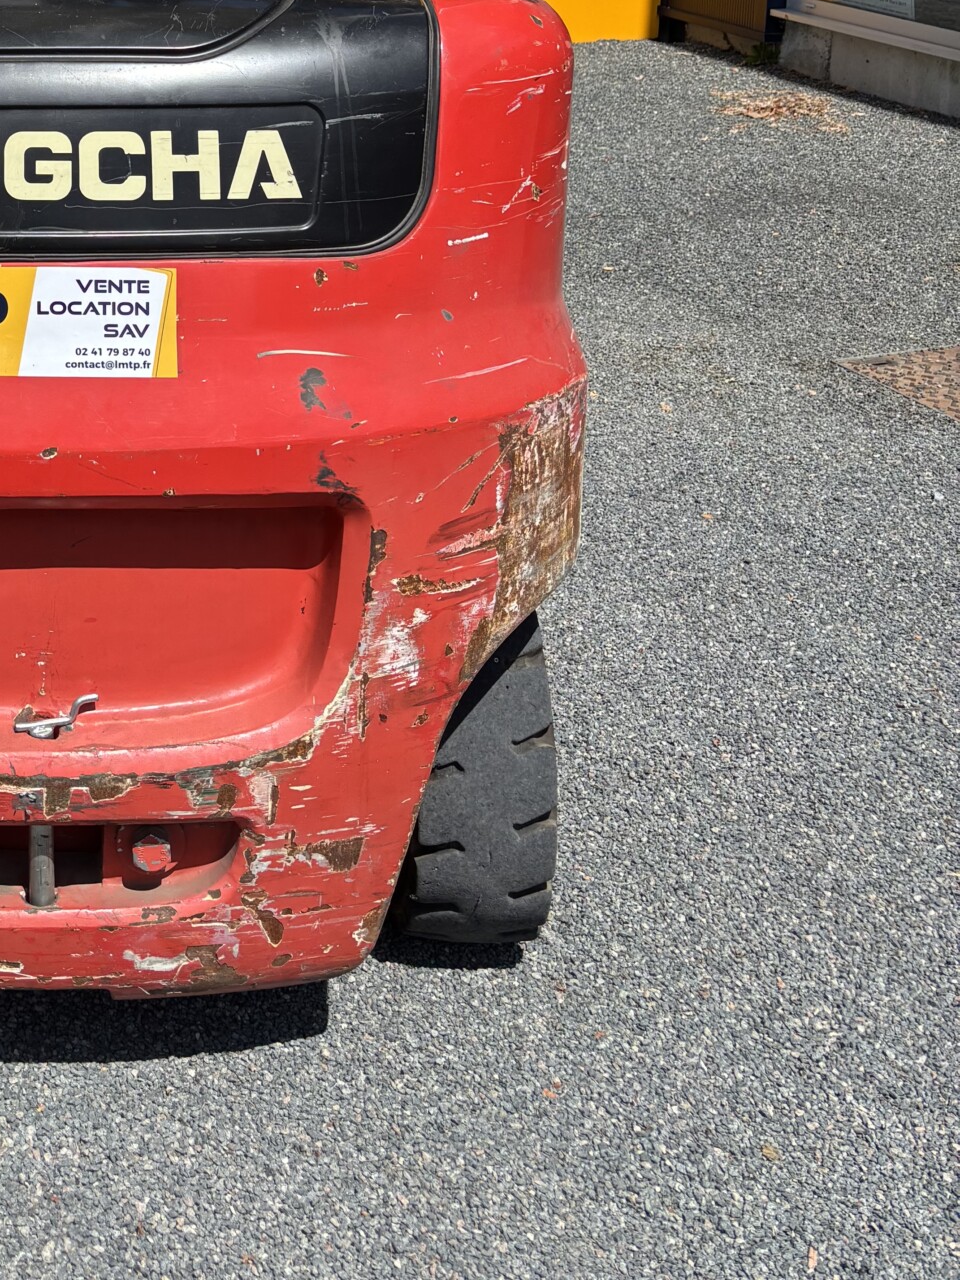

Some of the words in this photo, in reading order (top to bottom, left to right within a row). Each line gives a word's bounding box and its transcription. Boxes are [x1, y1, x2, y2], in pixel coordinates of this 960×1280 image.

[76, 279, 150, 294] VENTE
[36, 301, 150, 316] LOCATION
[103, 324, 150, 338] SAV
[75, 348, 88, 357] 02
[91, 348, 103, 357] 41
[106, 348, 120, 357] 79
[122, 348, 136, 357] 87
[137, 348, 151, 357] 40
[65, 359, 152, 371] contact@lmtp.fr
